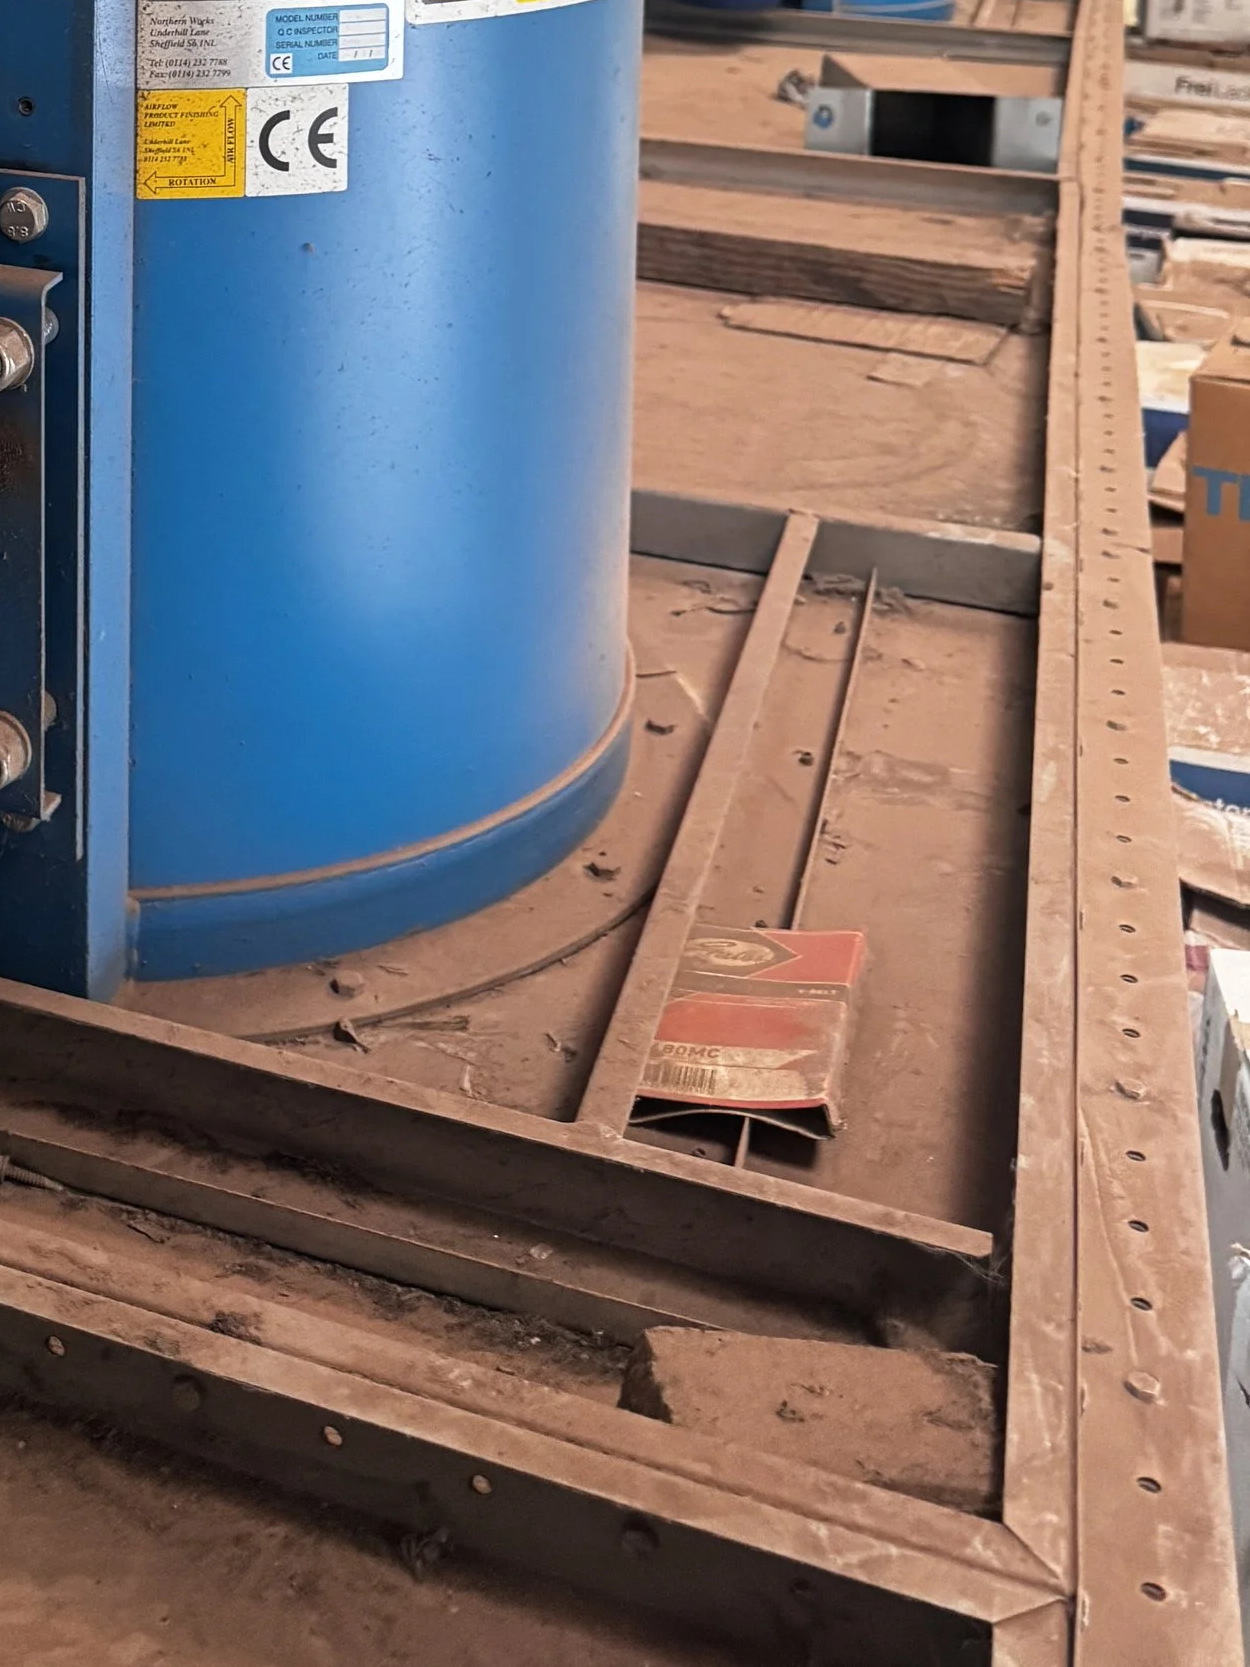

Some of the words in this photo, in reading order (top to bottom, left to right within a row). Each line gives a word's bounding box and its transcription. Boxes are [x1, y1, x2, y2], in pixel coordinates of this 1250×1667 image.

[150, 16, 187, 26] Northern
[275, 14, 304, 23] MODEL
[305, 13, 339, 22] NUMBER
[150, 28, 188, 37] Underhill
[190, 29, 210, 37] Lane
[294, 26, 339, 35] INSPECTOR
[150, 39, 185, 49] Sheffield
[275, 41, 304, 49] SERIAL
[305, 38, 339, 47] NUMBER
[317, 51, 338, 60] DATE
[165, 58, 191, 68] (0114)
[193, 58, 207, 66] 232
[272, 56, 291, 71] CE
[168, 69, 194, 79] (0114)
[196, 69, 210, 78] 232
[227, 118, 235, 145] FLOW
[259, 106, 338, 172] CE
[227, 148, 235, 164] AIR
[168, 177, 216, 186] ROTATION
